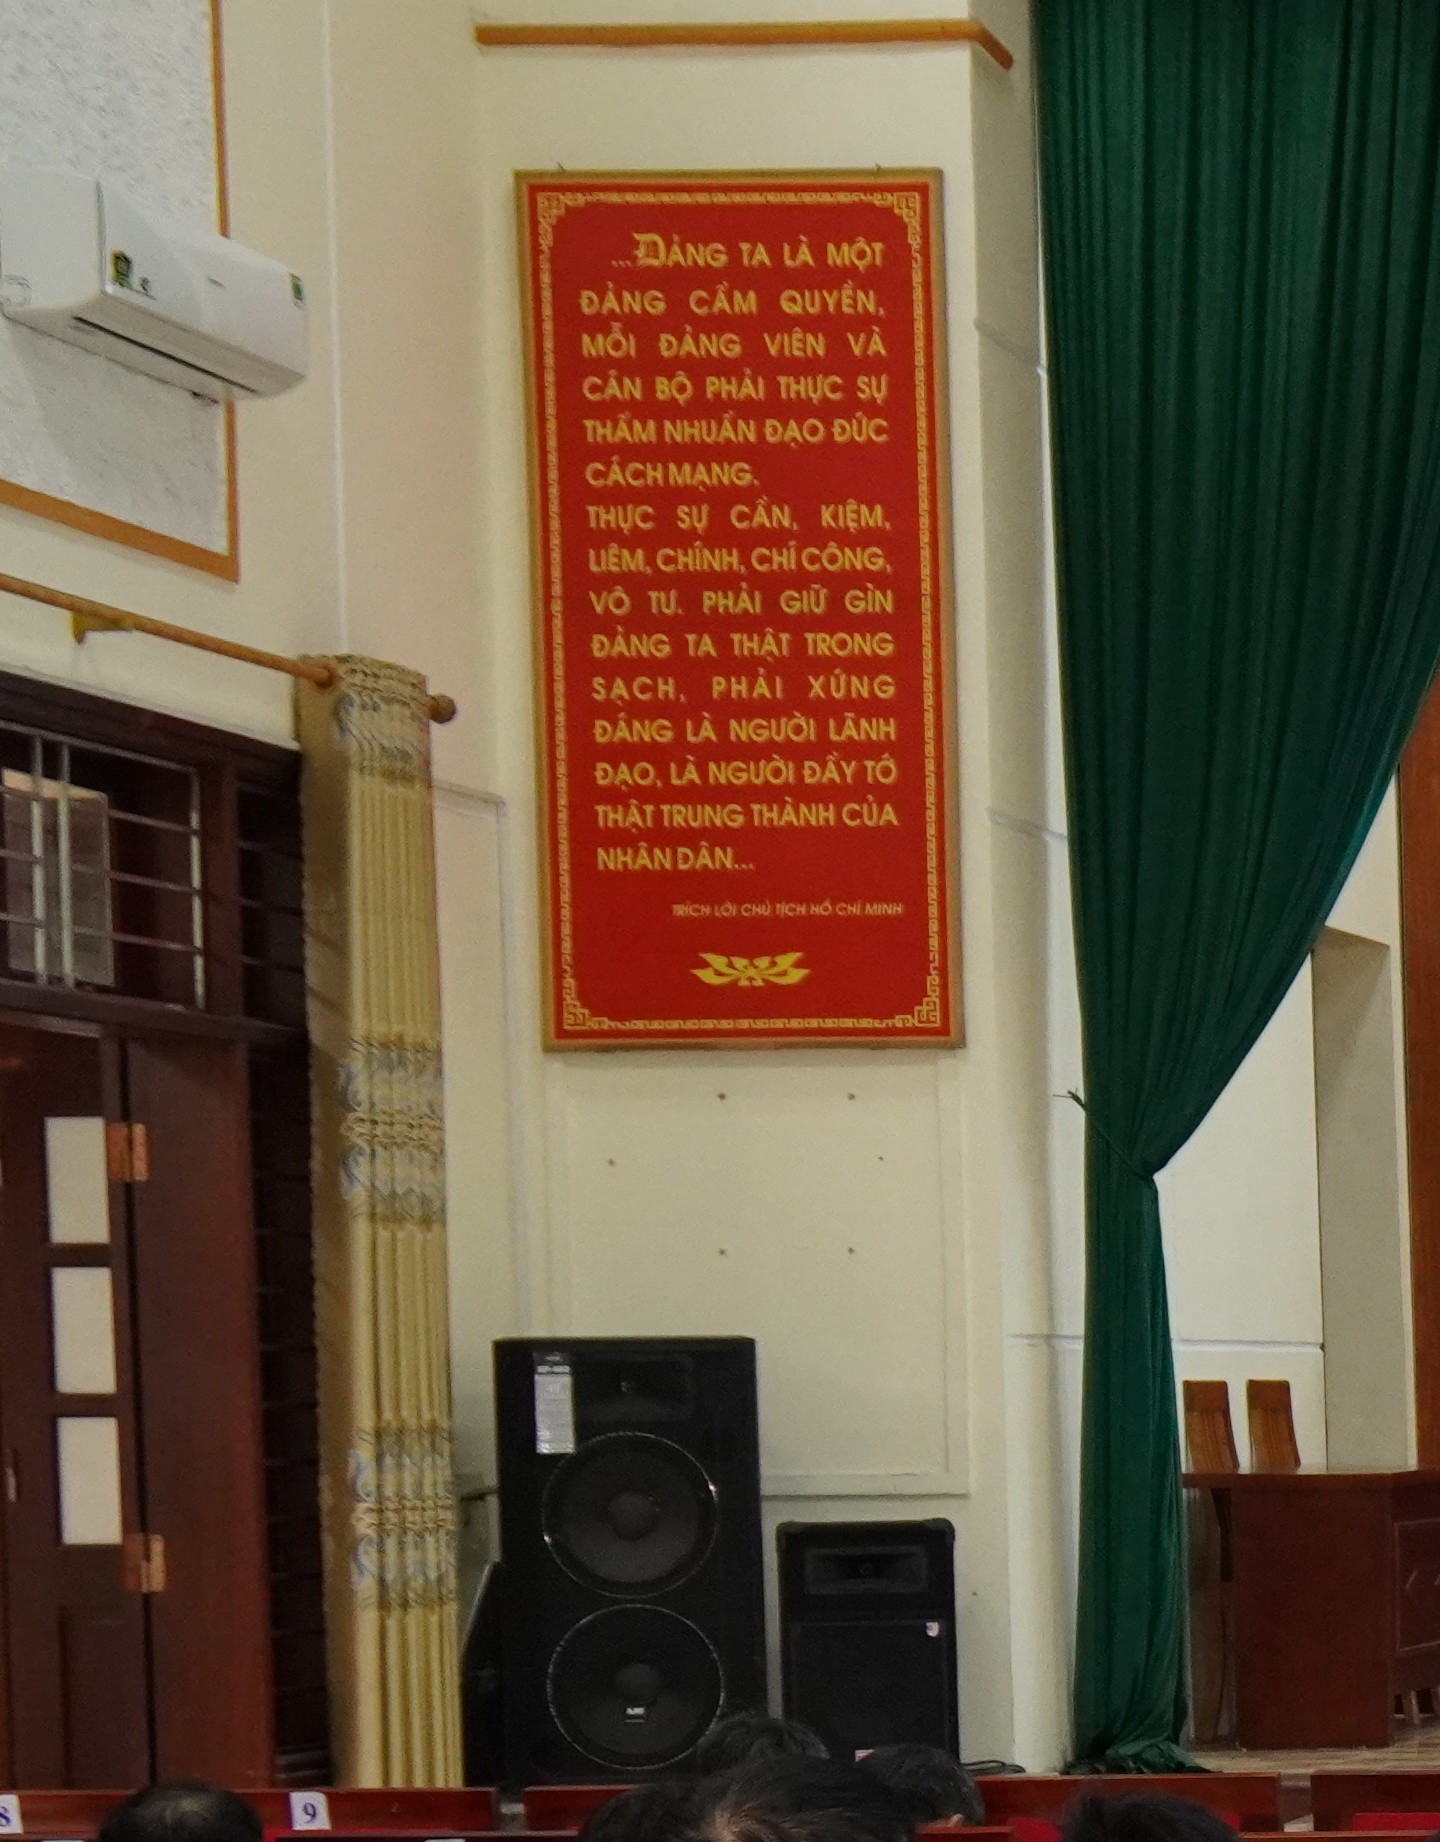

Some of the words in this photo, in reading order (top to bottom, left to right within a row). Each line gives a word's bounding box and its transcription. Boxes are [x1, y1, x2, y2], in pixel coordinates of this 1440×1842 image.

[739, 242, 771, 267] TA
[782, 236, 814, 267] LÀ
[826, 236, 884, 272] MỘT
[579, 281, 666, 316] ĐẢNG
[689, 281, 758, 316] CẦM
[659, 325, 741, 359] ĐẢNG
[764, 328, 825, 359] VIÊN
[847, 326, 887, 358] VÀ
[655, 370, 693, 408] BỘ
[706, 367, 765, 401] PHẢI
[777, 374, 843, 406] THỰC
[856, 374, 887, 406] SỰ
[764, 418, 825, 449] ĐẠO
[586, 505, 655, 535] THỰC
[676, 505, 708, 535] SỰ
[821, 499, 891, 535] KIỆM,
[588, 543, 652, 574] LIÊM,
[750, 542, 797, 573] CHÍ
[801, 542, 892, 574] CÔNG,
[590, 586, 630, 615] VÔ
[702, 583, 761, 615] PHẢI
[844, 583, 893, 615] GÌN
[591, 624, 671, 658] ĐẢNG
[684, 633, 717, 658] TA
[732, 626, 790, 664] THẬT
[805, 631, 894, 658] TRONG
[590, 676, 686, 706] SẠCH,
[711, 668, 783, 701] PHẢI
[685, 712, 716, 743] LÀ
[729, 710, 815, 744] NGƯỜI
[594, 761, 662, 792] ĐẠO,
[669, 755, 703, 786] LÀ
[708, 752, 794, 785] NGƯỜI
[594, 799, 655, 834] THẬT
[661, 803, 745, 828] TRUNG
[751, 796, 835, 828] THÀNH
[841, 795, 899, 828] CỦA
[596, 840, 672, 871] NHÂN
[302, 1802, 318, 1824] 9
